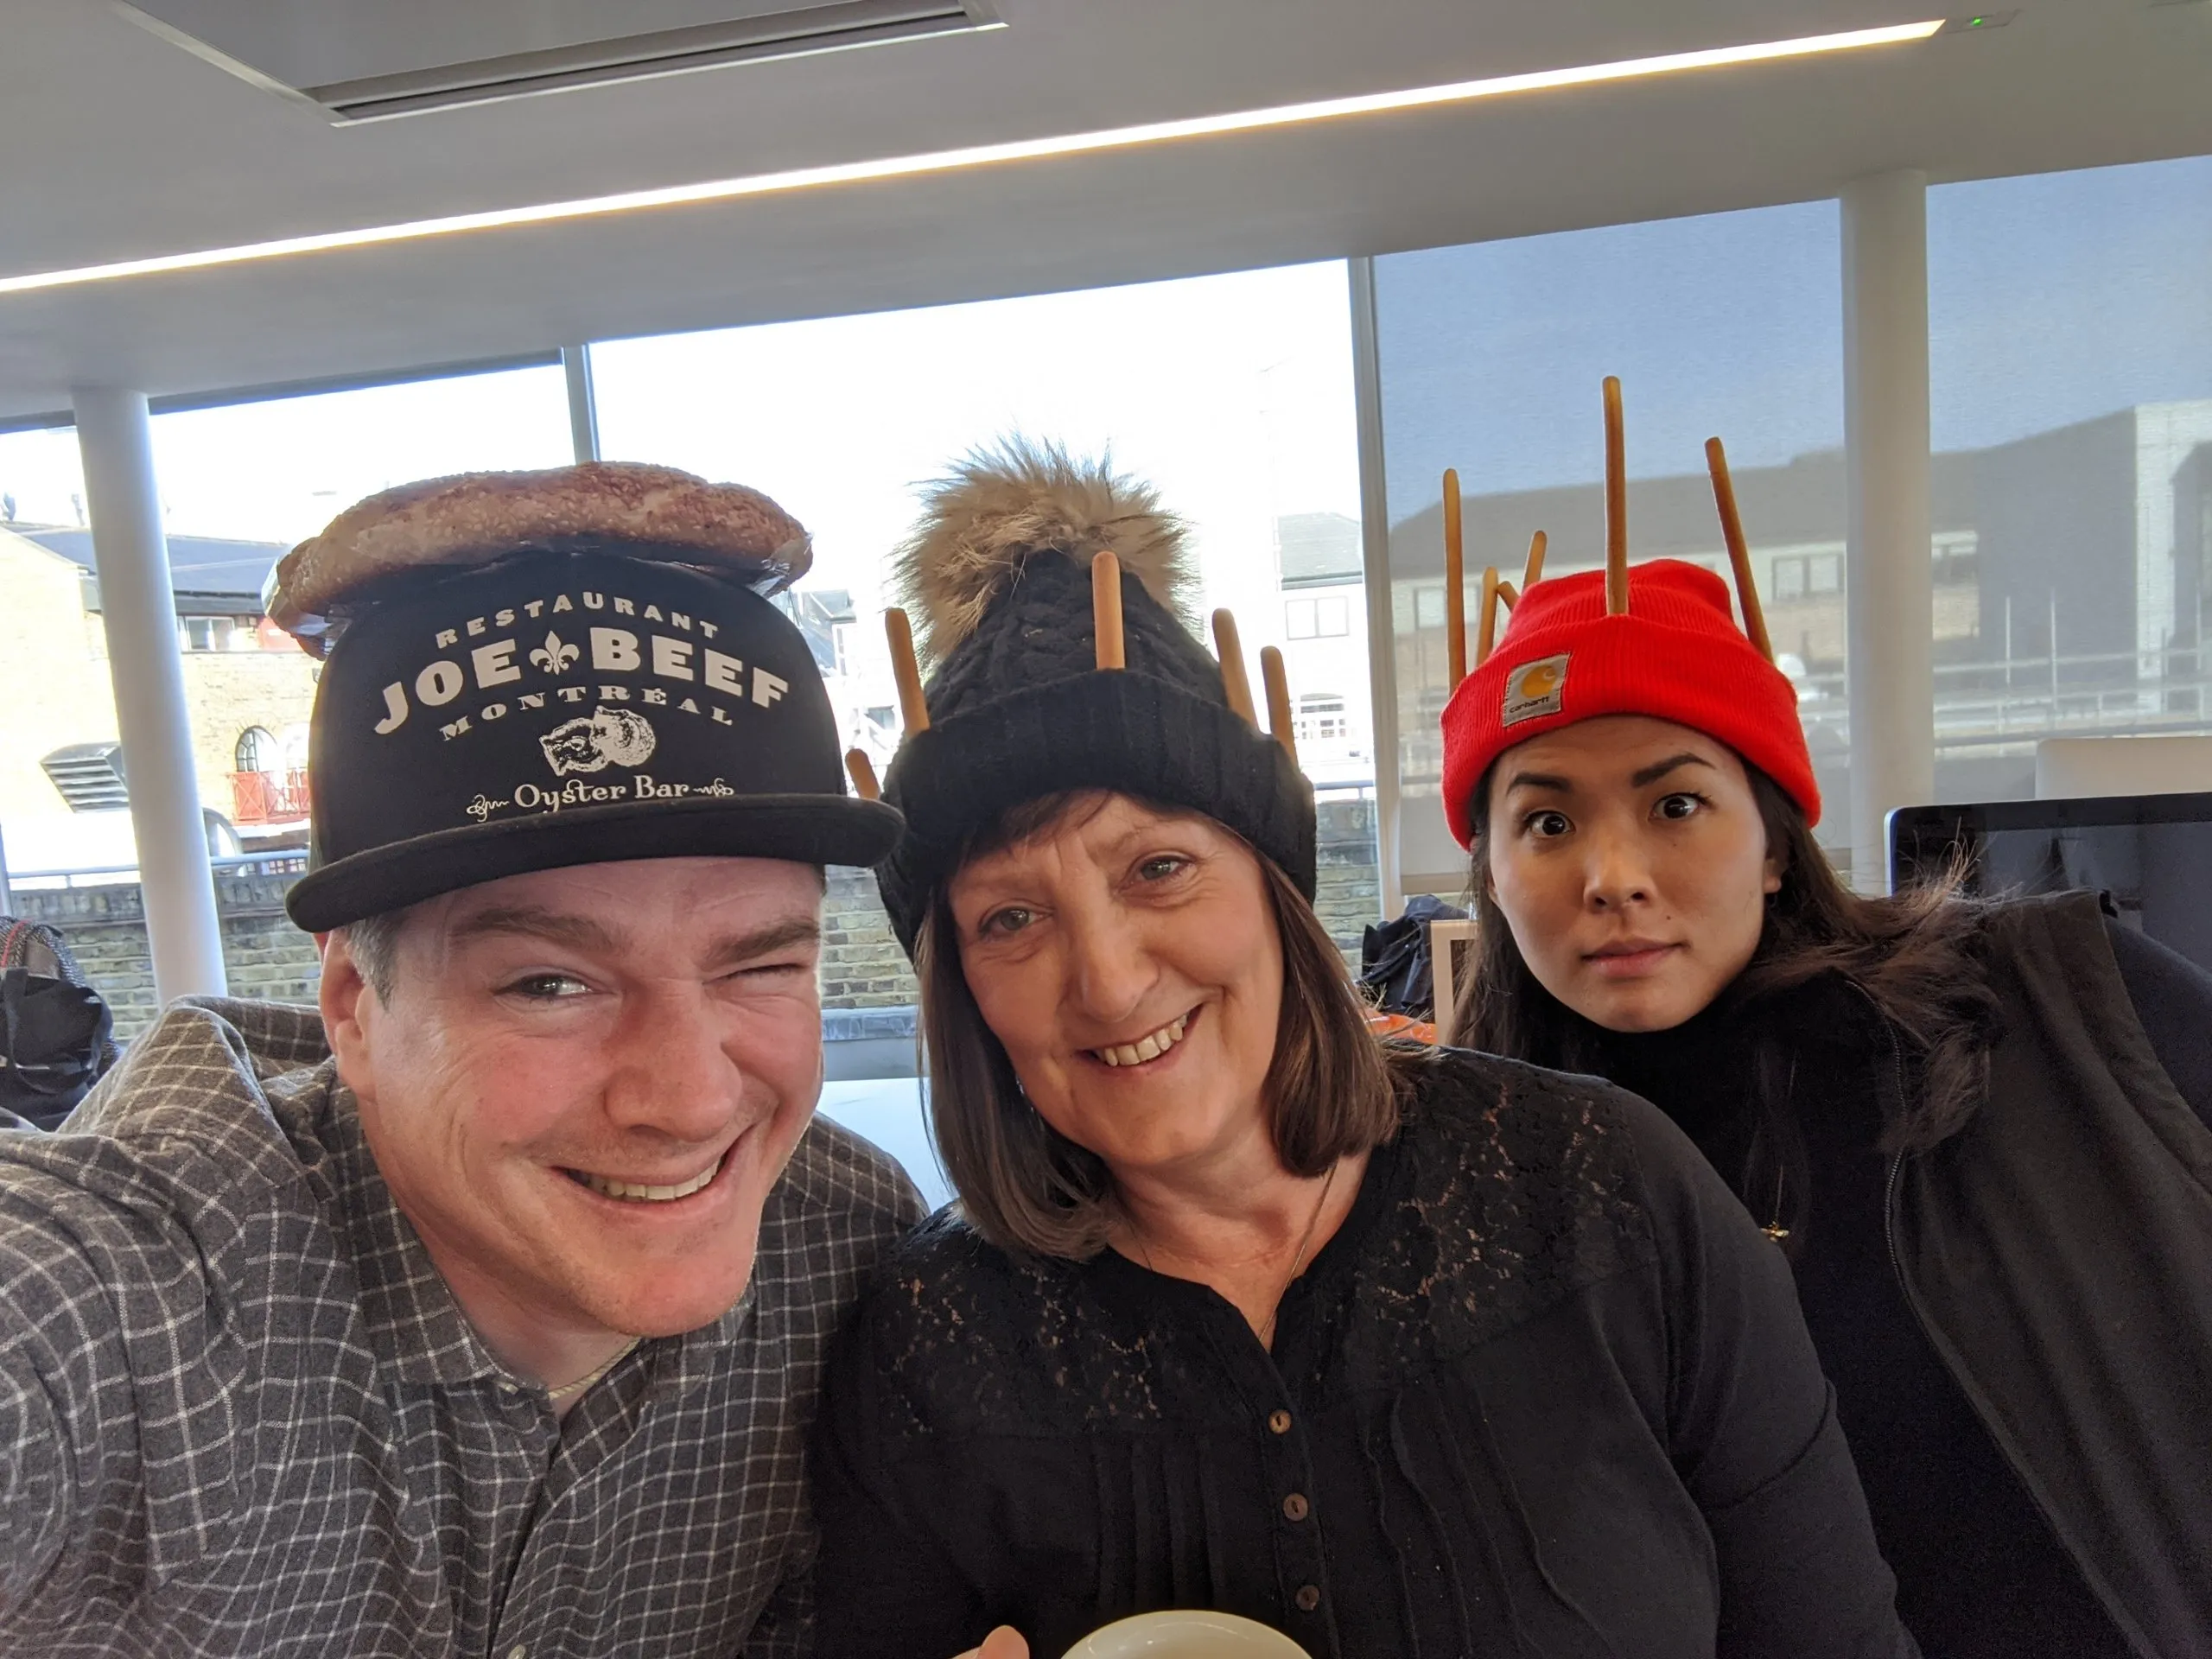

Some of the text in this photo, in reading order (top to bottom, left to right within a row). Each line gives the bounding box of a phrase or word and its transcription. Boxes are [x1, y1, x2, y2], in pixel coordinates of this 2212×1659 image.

[435, 591, 718, 649] RESTAURANT
[373, 626, 789, 734] JOE BEEF
[514, 774, 690, 814] Oyster Bar
